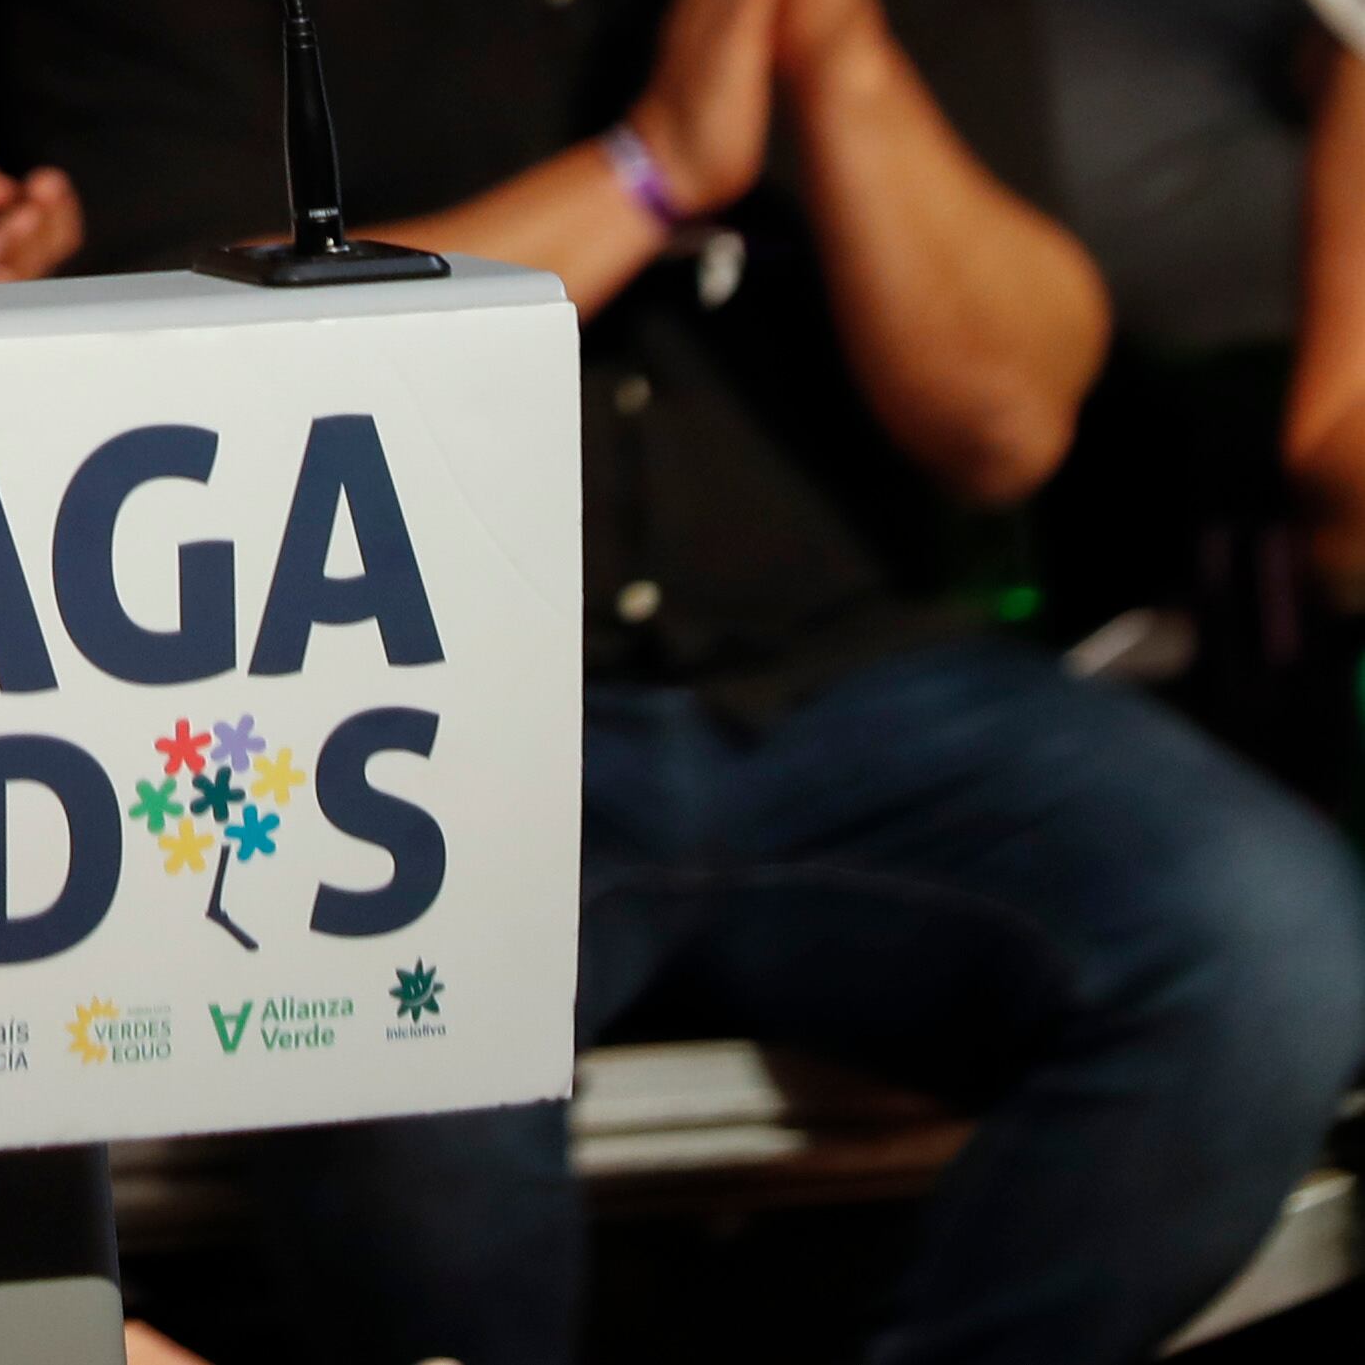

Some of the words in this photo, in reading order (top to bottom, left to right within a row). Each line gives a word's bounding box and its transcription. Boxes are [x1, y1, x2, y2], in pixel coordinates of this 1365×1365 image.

[261, 996, 354, 1022] Alianza
[93, 1018, 171, 1043] VERDES
[260, 1022, 335, 1051] Verde
[111, 1041, 171, 1064] EQUO
